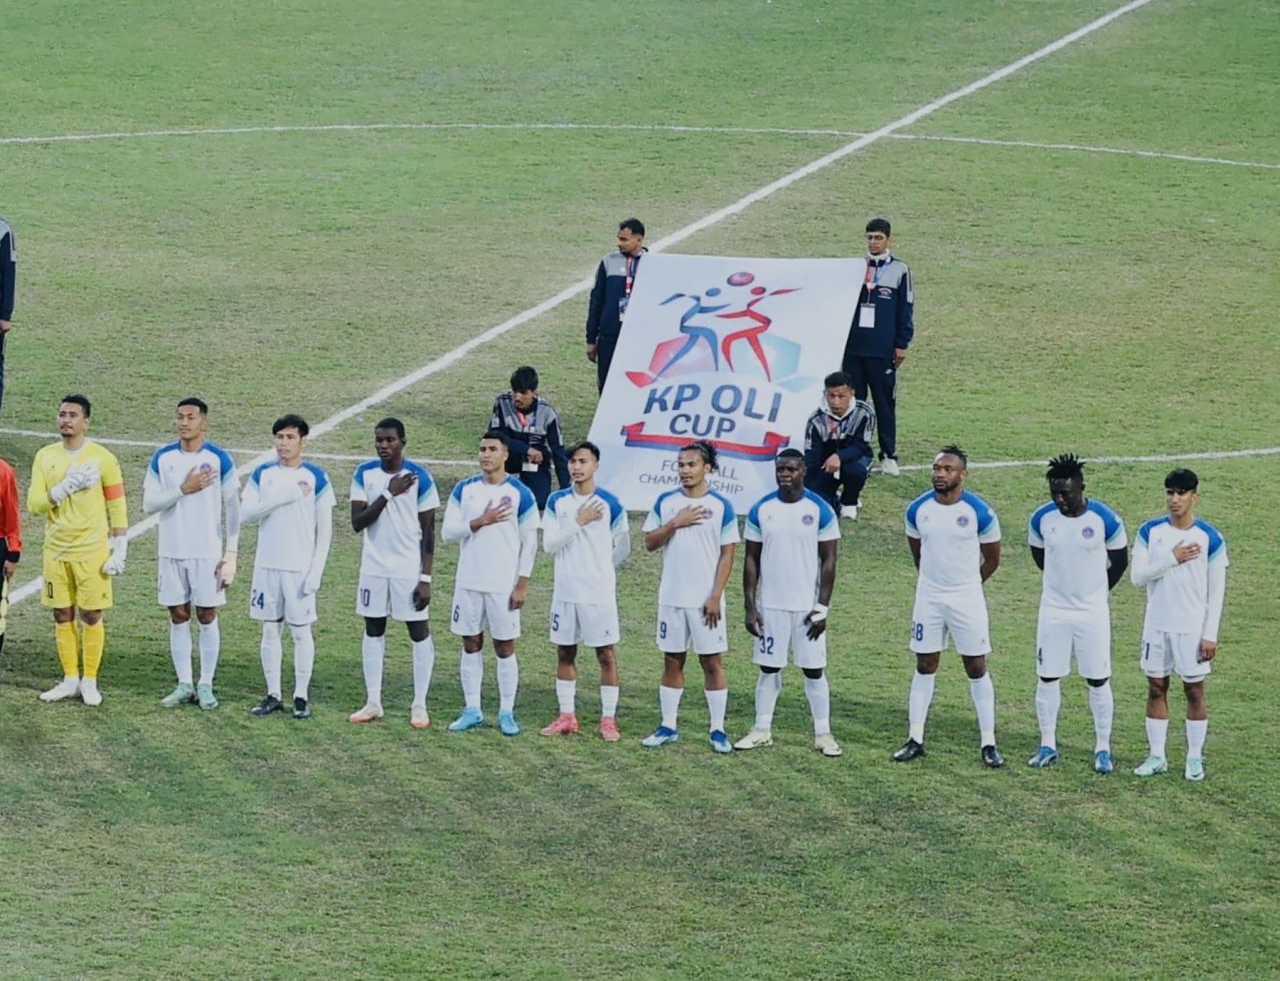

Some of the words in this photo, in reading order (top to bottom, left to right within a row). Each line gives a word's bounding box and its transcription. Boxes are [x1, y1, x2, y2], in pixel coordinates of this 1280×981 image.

[643, 383, 701, 414] KP
[711, 384, 782, 422] OLI
[670, 413, 736, 438] CUP
[251, 589, 264, 609] 24
[660, 621, 667, 639] 9
[760, 635, 774, 655] 32
